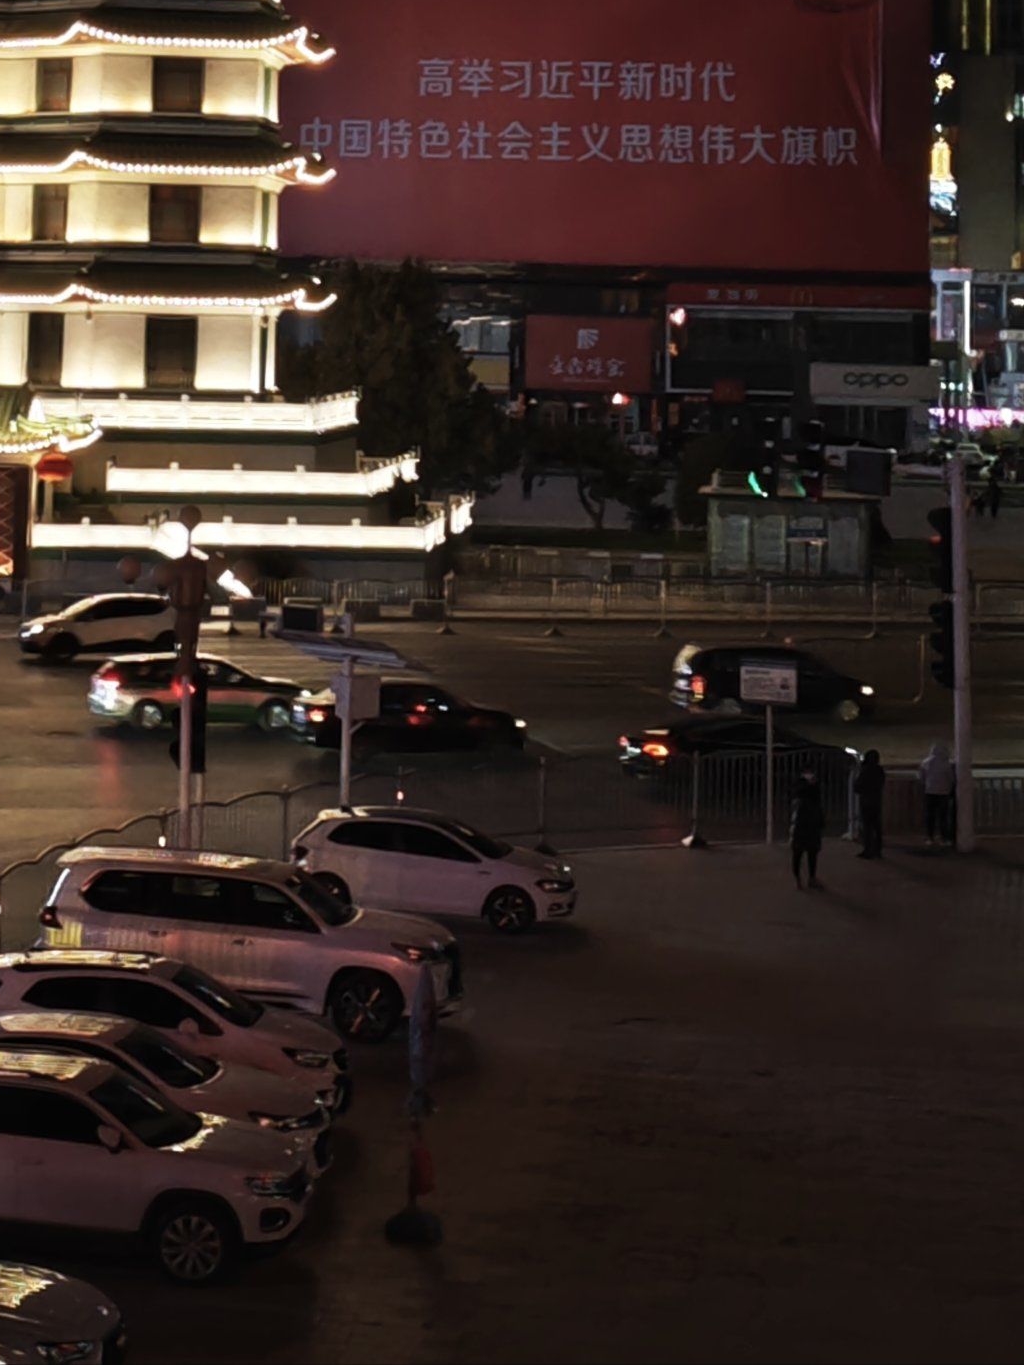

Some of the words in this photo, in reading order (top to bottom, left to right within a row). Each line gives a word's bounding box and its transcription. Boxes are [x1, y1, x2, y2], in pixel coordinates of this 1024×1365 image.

[418, 58, 736, 102] 高举习近平新时代
[300, 117, 858, 166] 中国特色社会主义思想伟大旗帜
